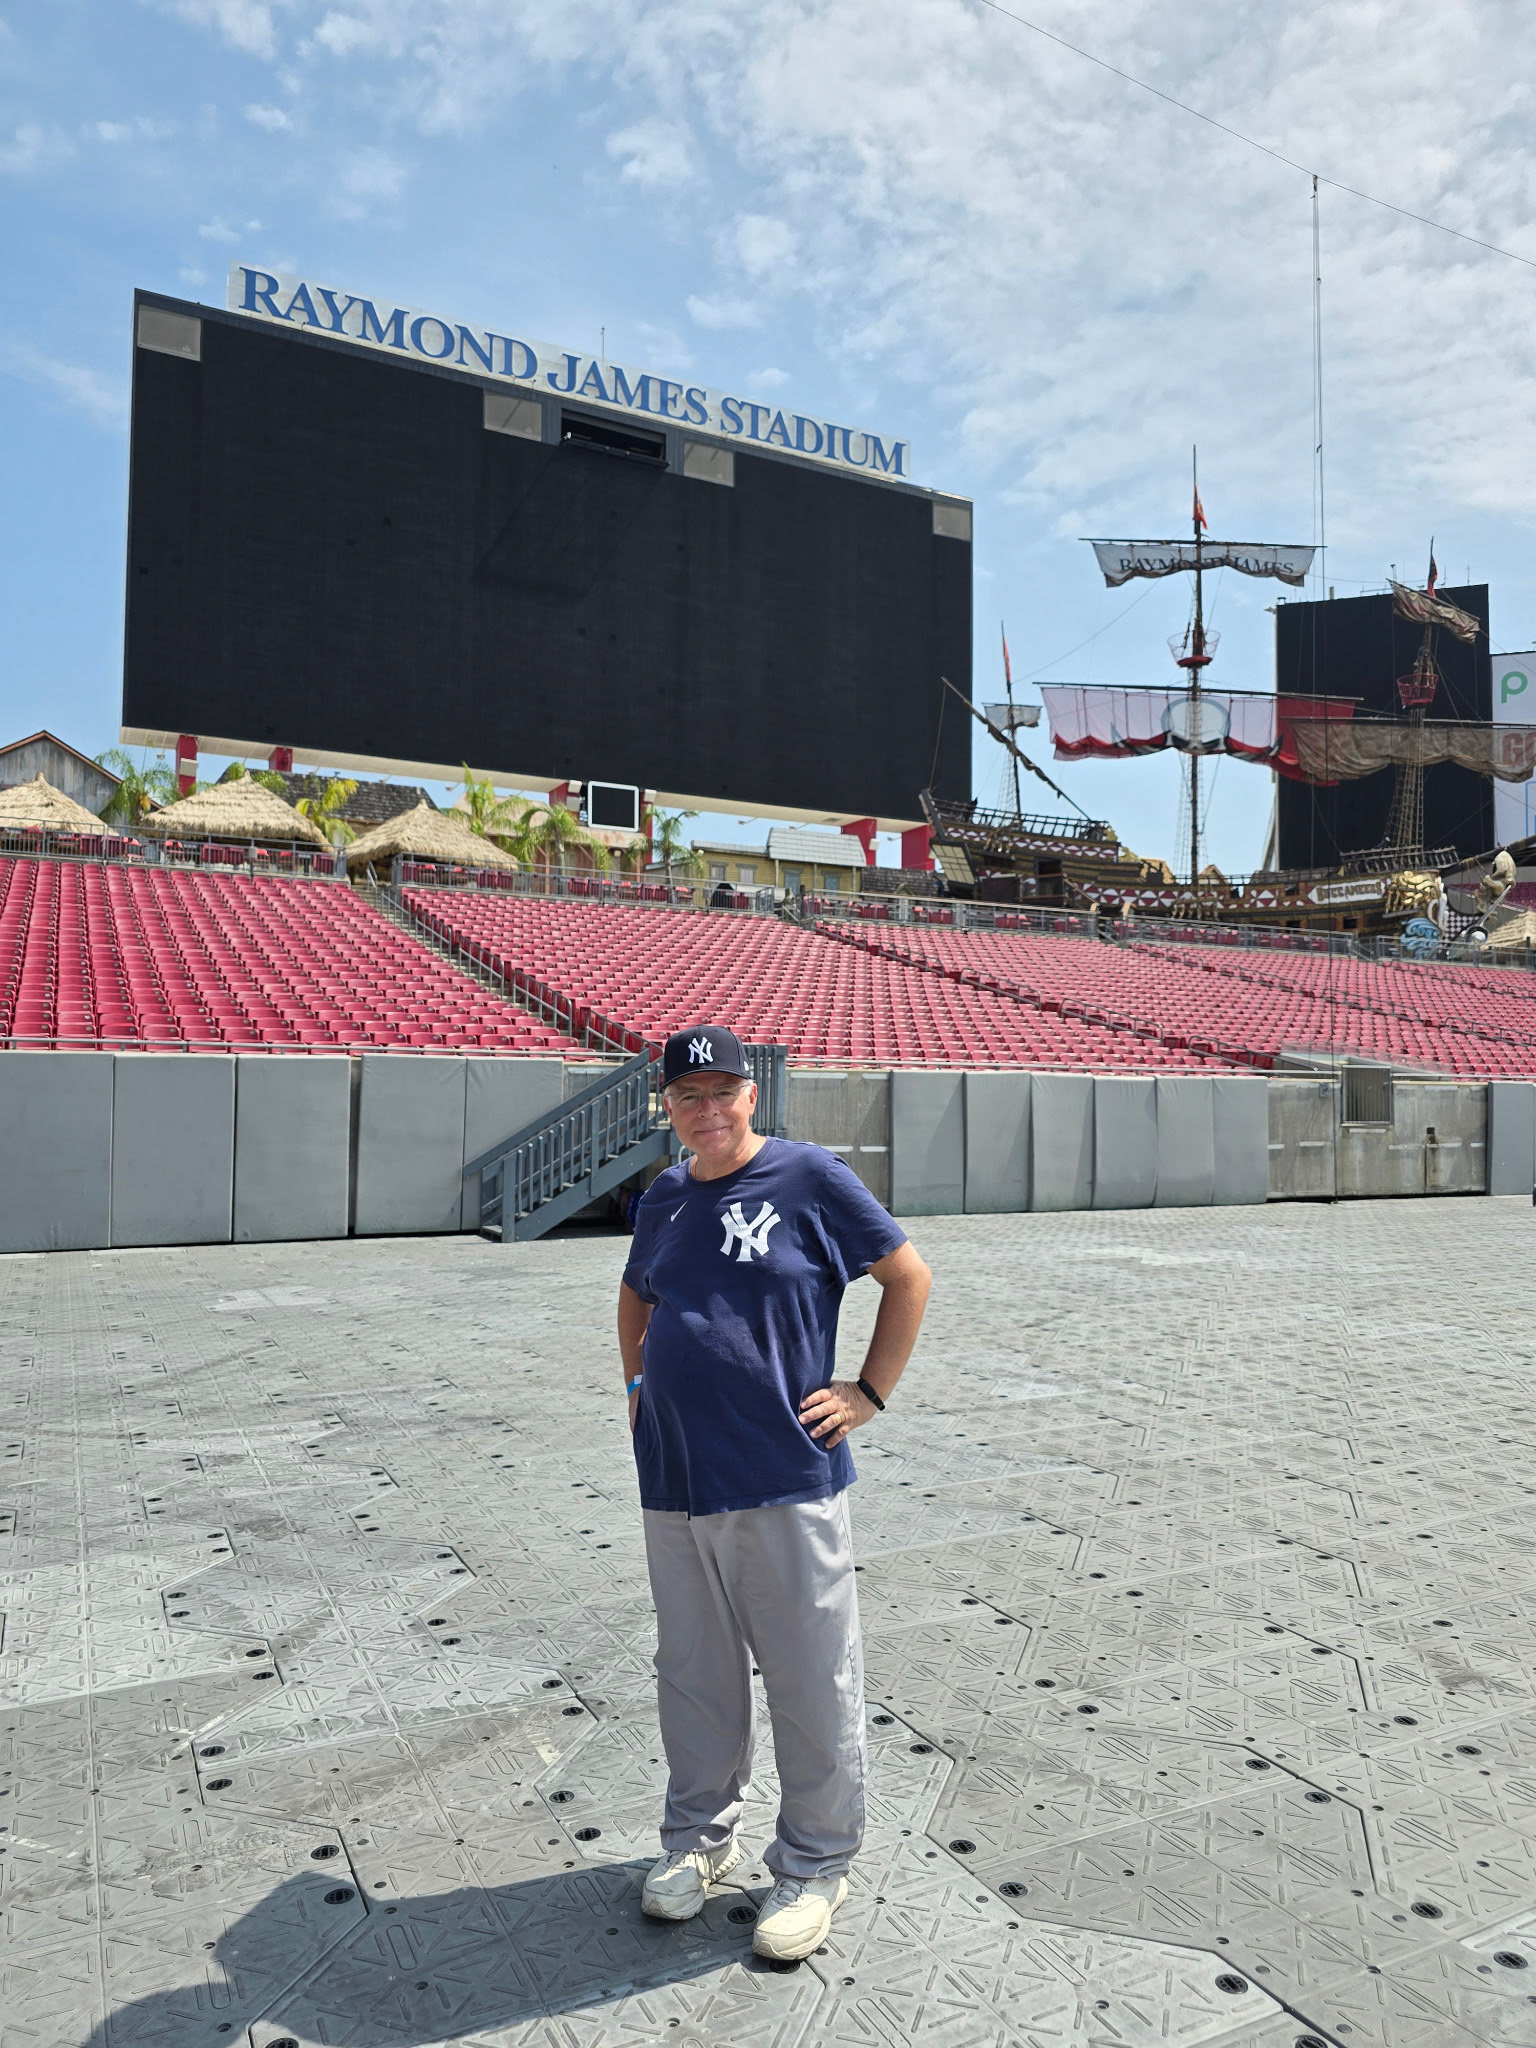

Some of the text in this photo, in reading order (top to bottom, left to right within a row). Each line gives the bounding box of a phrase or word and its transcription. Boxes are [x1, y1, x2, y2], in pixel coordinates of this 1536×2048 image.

[238, 266, 908, 476] RAYMOND JAMES STADIUM
[1233, 556, 1294, 574] JAMES
[1316, 881, 1382, 902] BUCCANEERS
[688, 1036, 713, 1063] NY
[720, 1201, 781, 1262] NY
